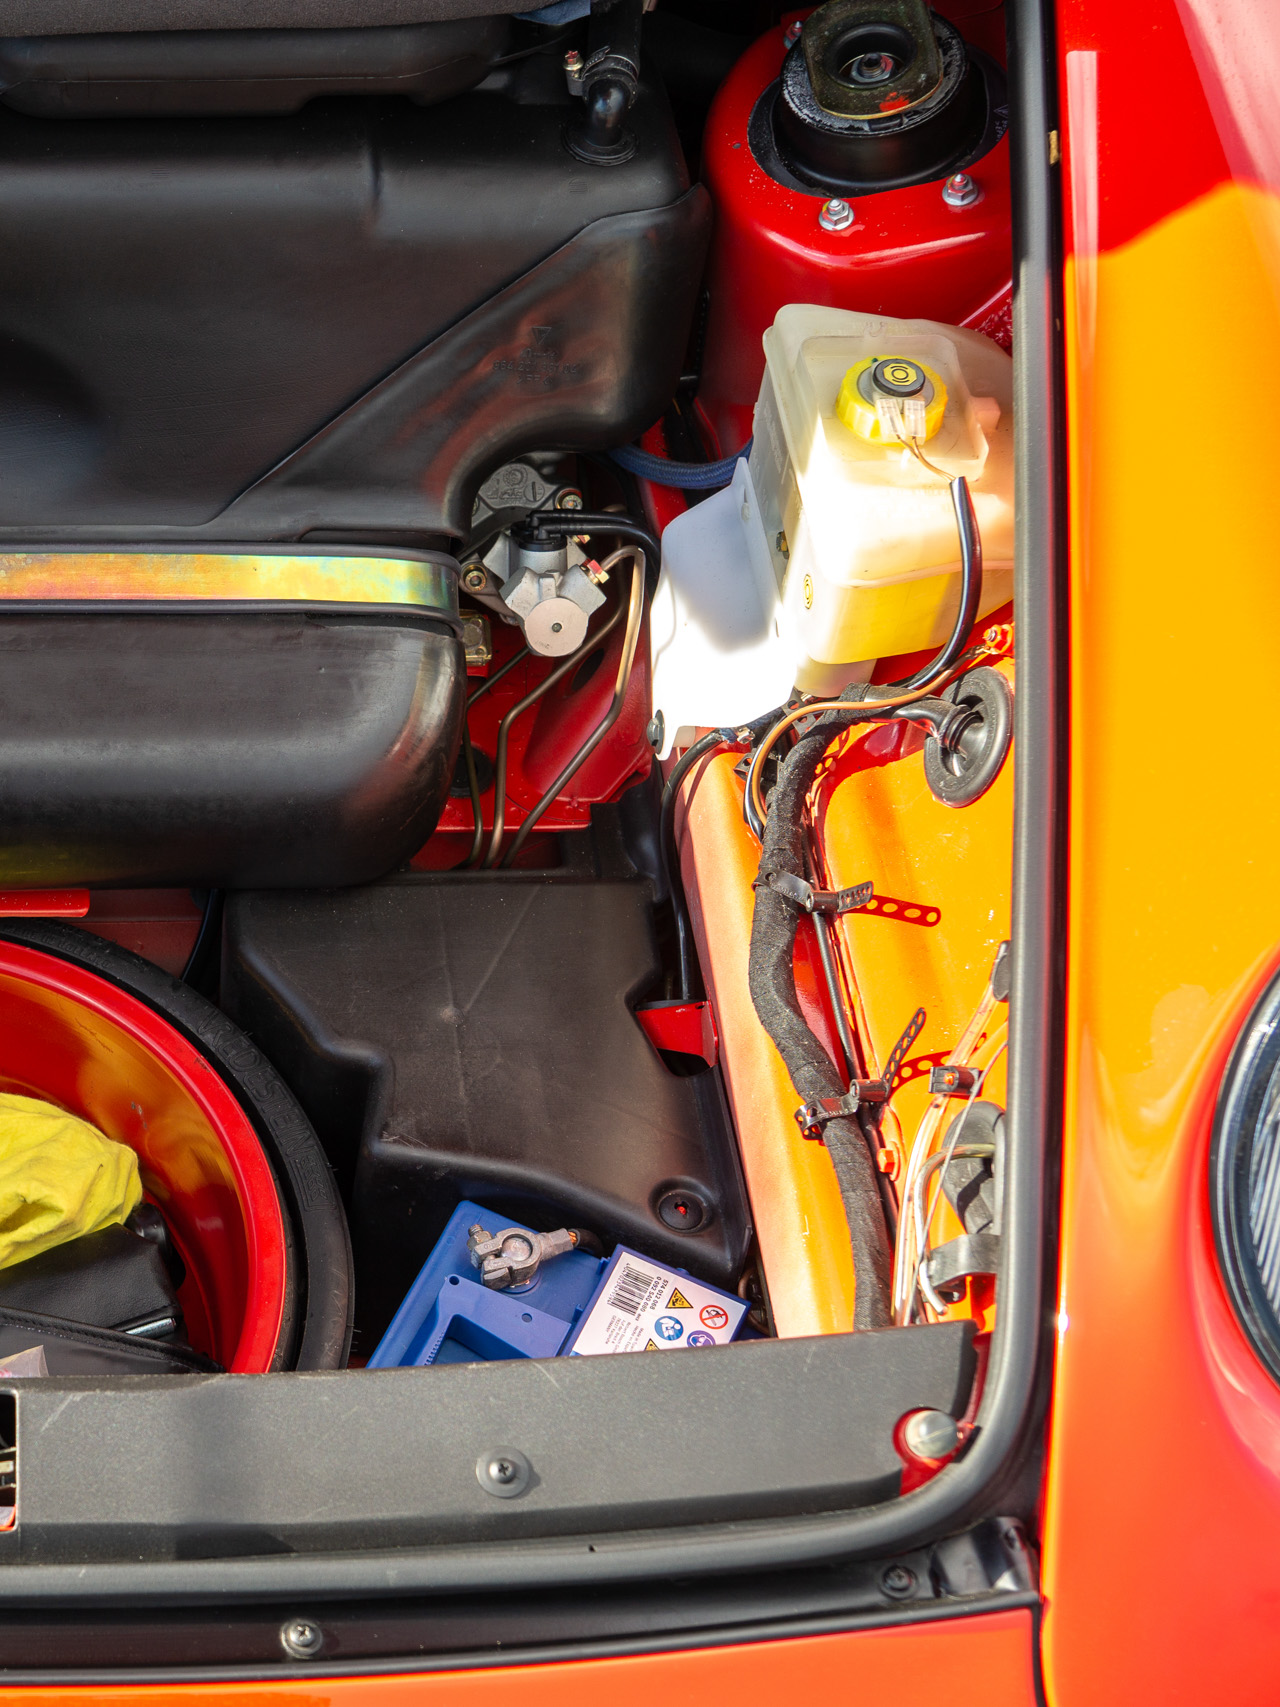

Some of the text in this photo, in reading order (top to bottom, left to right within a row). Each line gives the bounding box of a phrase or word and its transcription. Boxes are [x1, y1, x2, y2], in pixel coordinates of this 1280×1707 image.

[192, 1008, 319, 1160] VREDESTEIN
[648, 1278, 669, 1311] 574 012 068
[650, 1279, 660, 1291] 092
[605, 1314, 616, 1333] GERMANY
